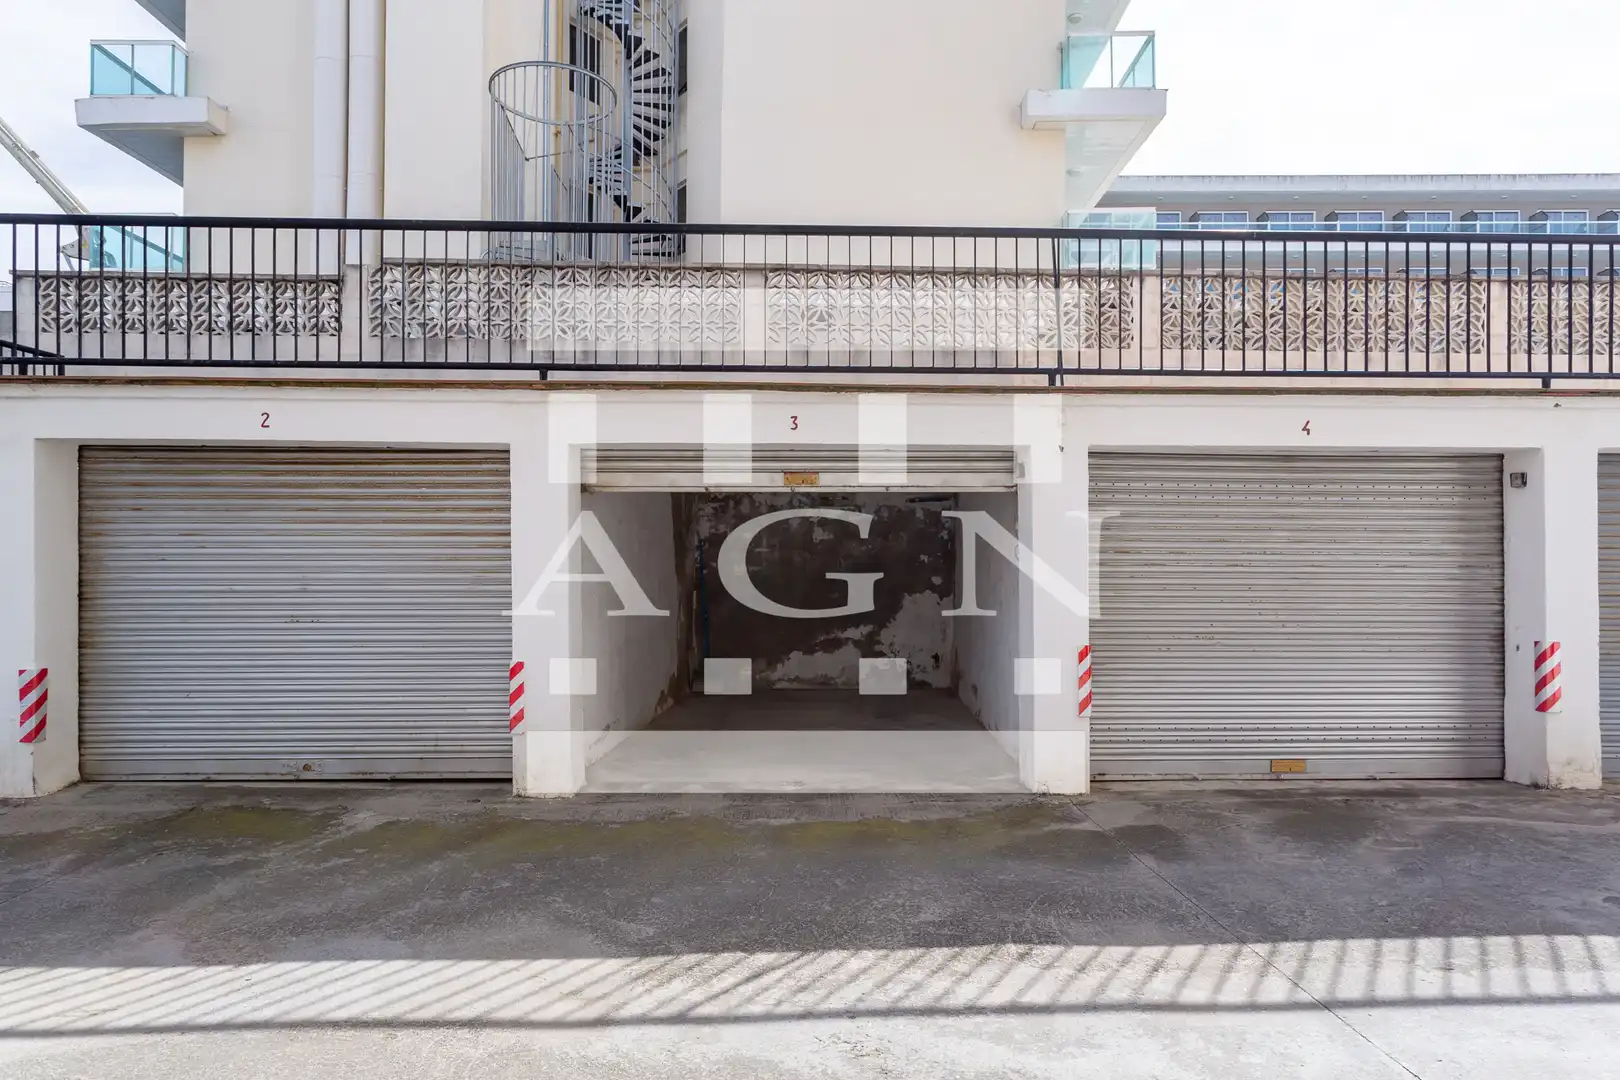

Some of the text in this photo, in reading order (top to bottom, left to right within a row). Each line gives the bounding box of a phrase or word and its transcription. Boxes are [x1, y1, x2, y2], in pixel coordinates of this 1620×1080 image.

[260, 411, 271, 429] 2
[789, 414, 799, 431] 3
[1300, 419, 1311, 436] 4
